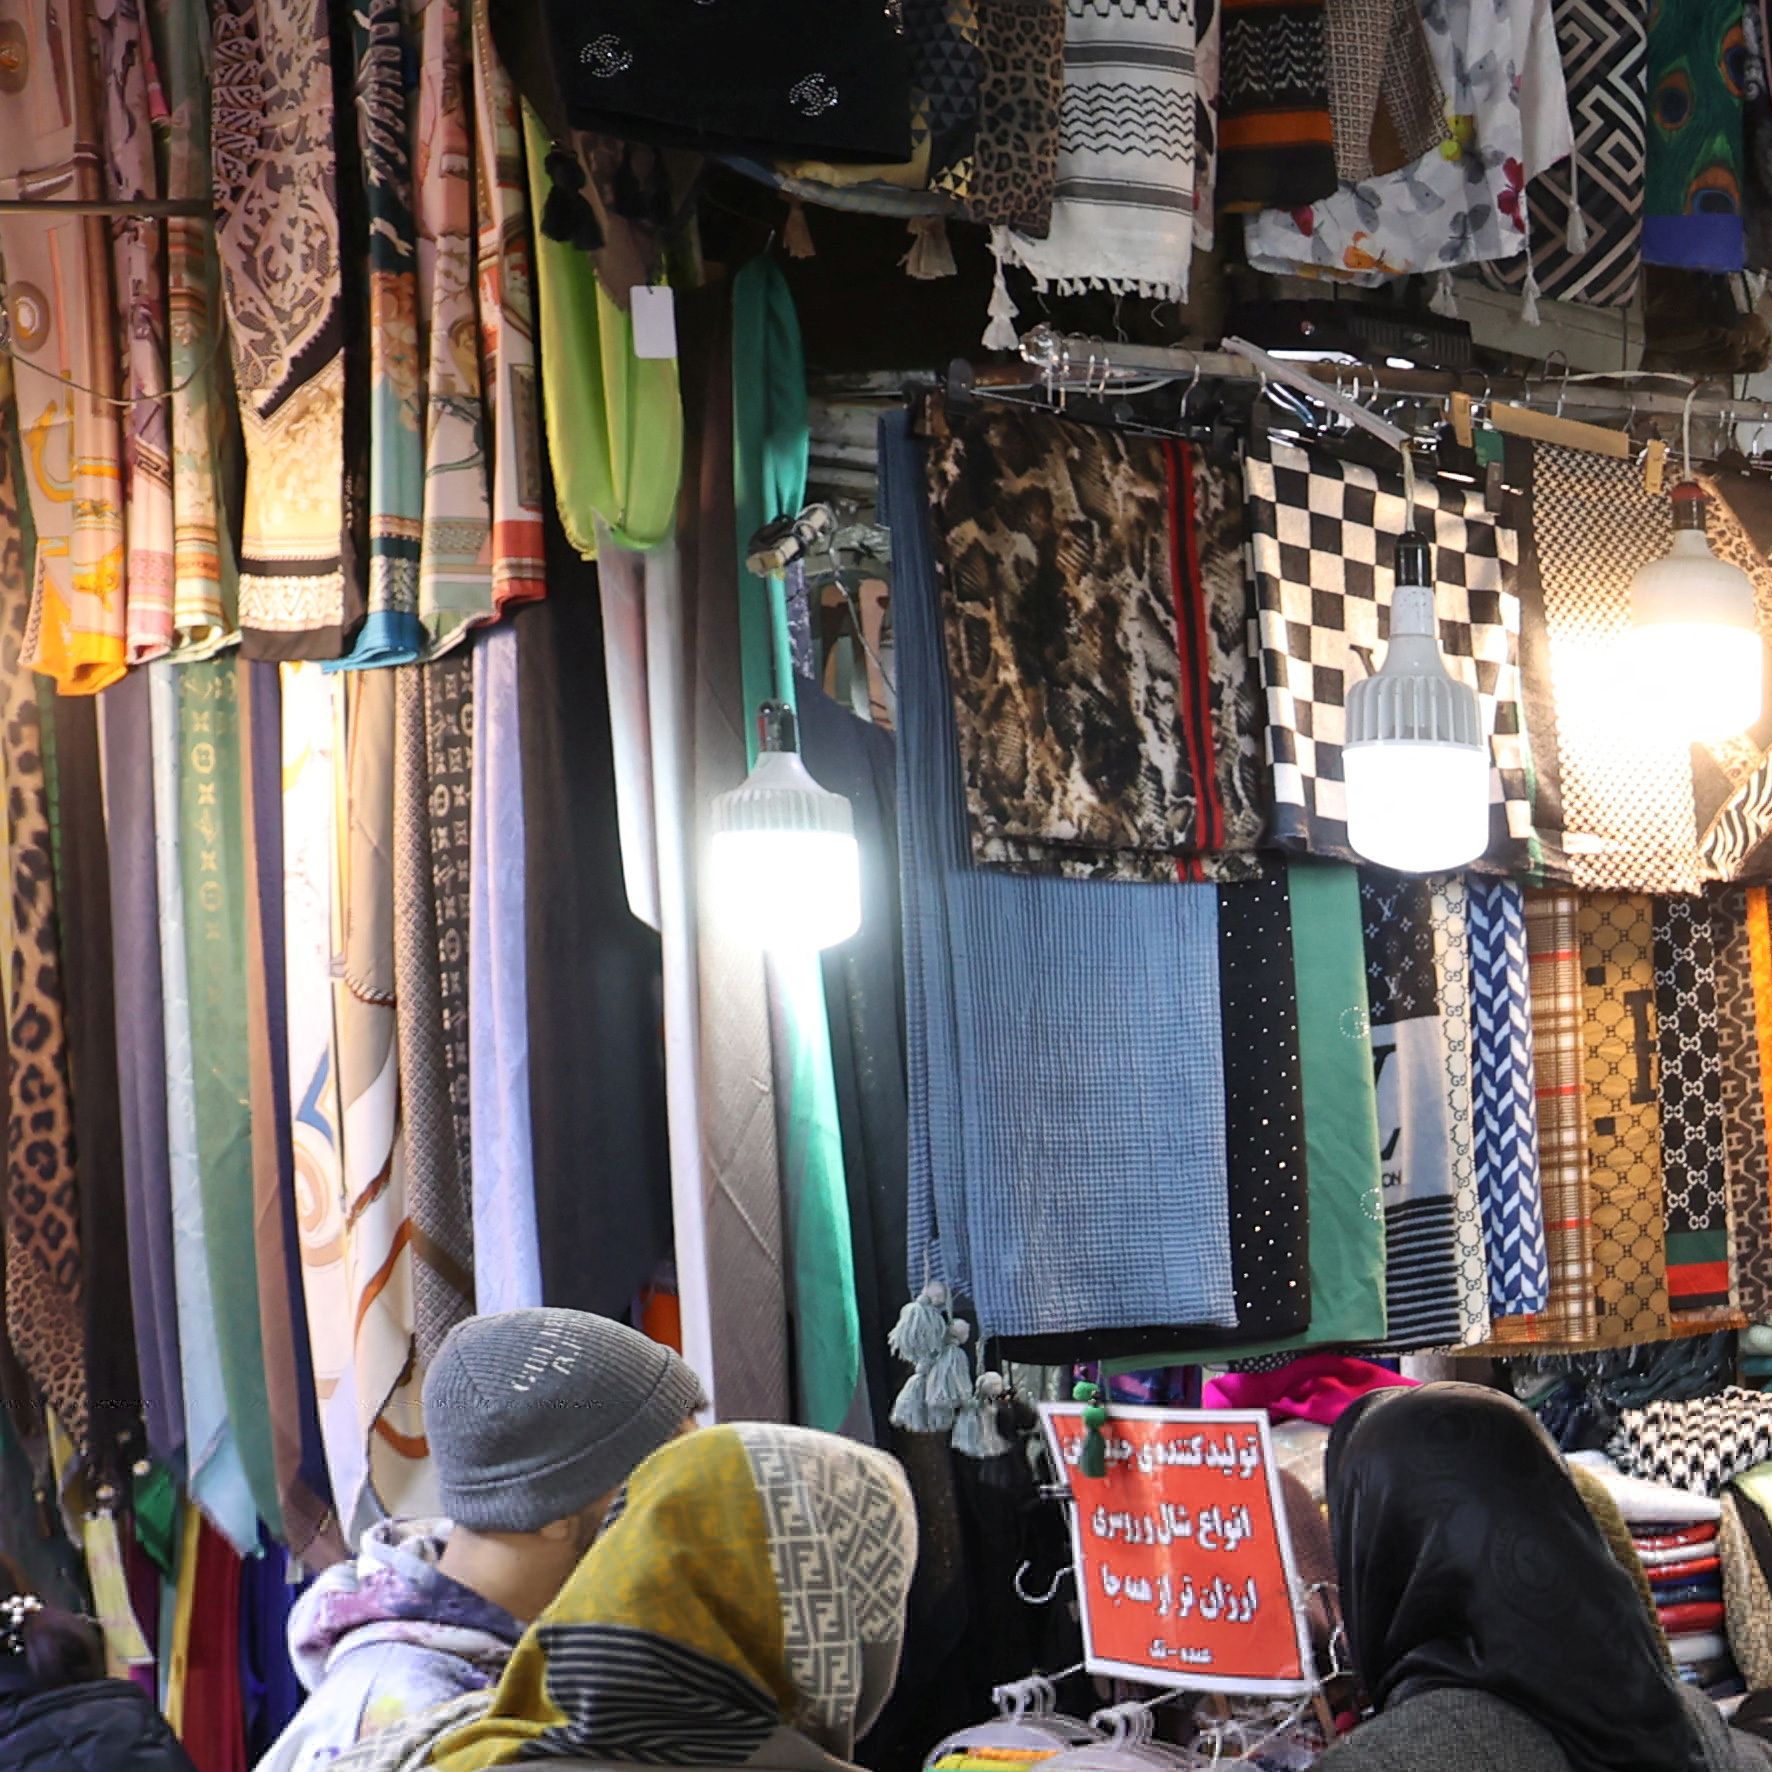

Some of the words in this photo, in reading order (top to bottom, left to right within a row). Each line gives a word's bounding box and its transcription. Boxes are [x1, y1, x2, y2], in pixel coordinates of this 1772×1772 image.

[1205, 1434, 1260, 1478] تولید
[1197, 1503, 1252, 1550] انواع
[1177, 1575, 1194, 1617] تر
[1199, 1576, 1258, 1622] ارزان
